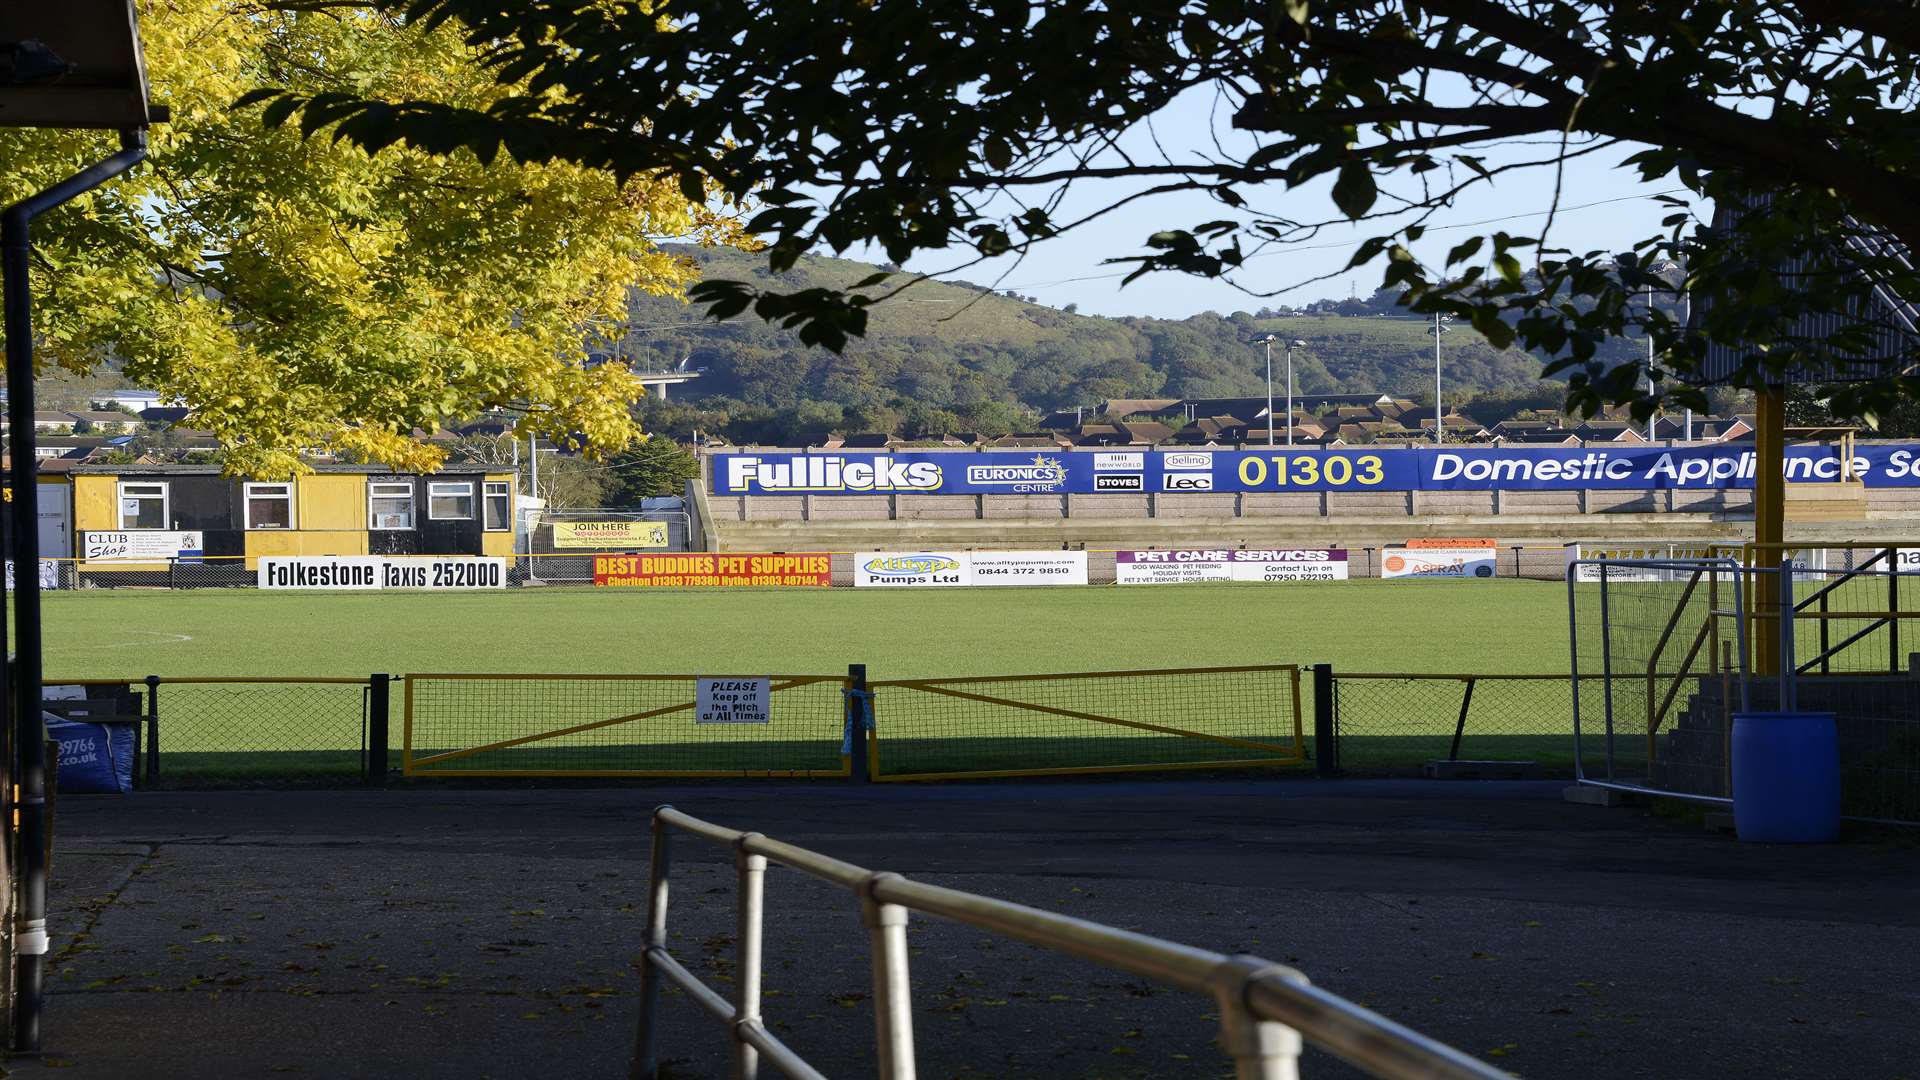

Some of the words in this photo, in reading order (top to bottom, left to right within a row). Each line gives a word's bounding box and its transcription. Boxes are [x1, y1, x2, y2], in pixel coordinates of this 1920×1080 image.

[1171, 456, 1205, 466] belling
[728, 457, 942, 491] Fullicks
[1238, 456, 1384, 486] 01303
[1432, 453, 1633, 481] Domestic
[1644, 453, 1870, 485] Applince
[973, 469, 1055, 481] EURONICS
[1013, 483, 1054, 492] CENTRE
[1100, 478, 1139, 488] STOVES
[1166, 475, 1211, 490] Lec
[573, 523, 599, 531] JOIN
[602, 523, 631, 531] HERE
[89, 534, 128, 544] CLUB
[89, 545, 127, 559] Shop
[1134, 552, 1171, 562] PET
[1175, 551, 1229, 561] CARE
[1234, 550, 1329, 561] SERVICES
[596, 558, 637, 574] BEST
[642, 557, 714, 574] BUDDIES
[719, 557, 747, 574] PET
[751, 557, 829, 574] SUPPLIES
[871, 558, 960, 572] Alltype
[1303, 565, 1319, 573] Lyn
[1412, 564, 1466, 573] ASPRAY
[268, 562, 374, 586] Folkestone
[383, 563, 426, 587] Taxis
[433, 563, 499, 587] 252000
[870, 575, 926, 584] Pumps
[932, 575, 959, 583] Ltd
[608, 577, 651, 586] Cheriton
[653, 576, 683, 586] 01303
[721, 576, 750, 586] Hythe
[752, 576, 782, 585] 01303
[711, 682, 758, 691] PLEASE
[712, 693, 738, 703] Keep
[743, 693, 756, 701] off
[733, 704, 758, 712] Pitch
[716, 712, 731, 721] All
